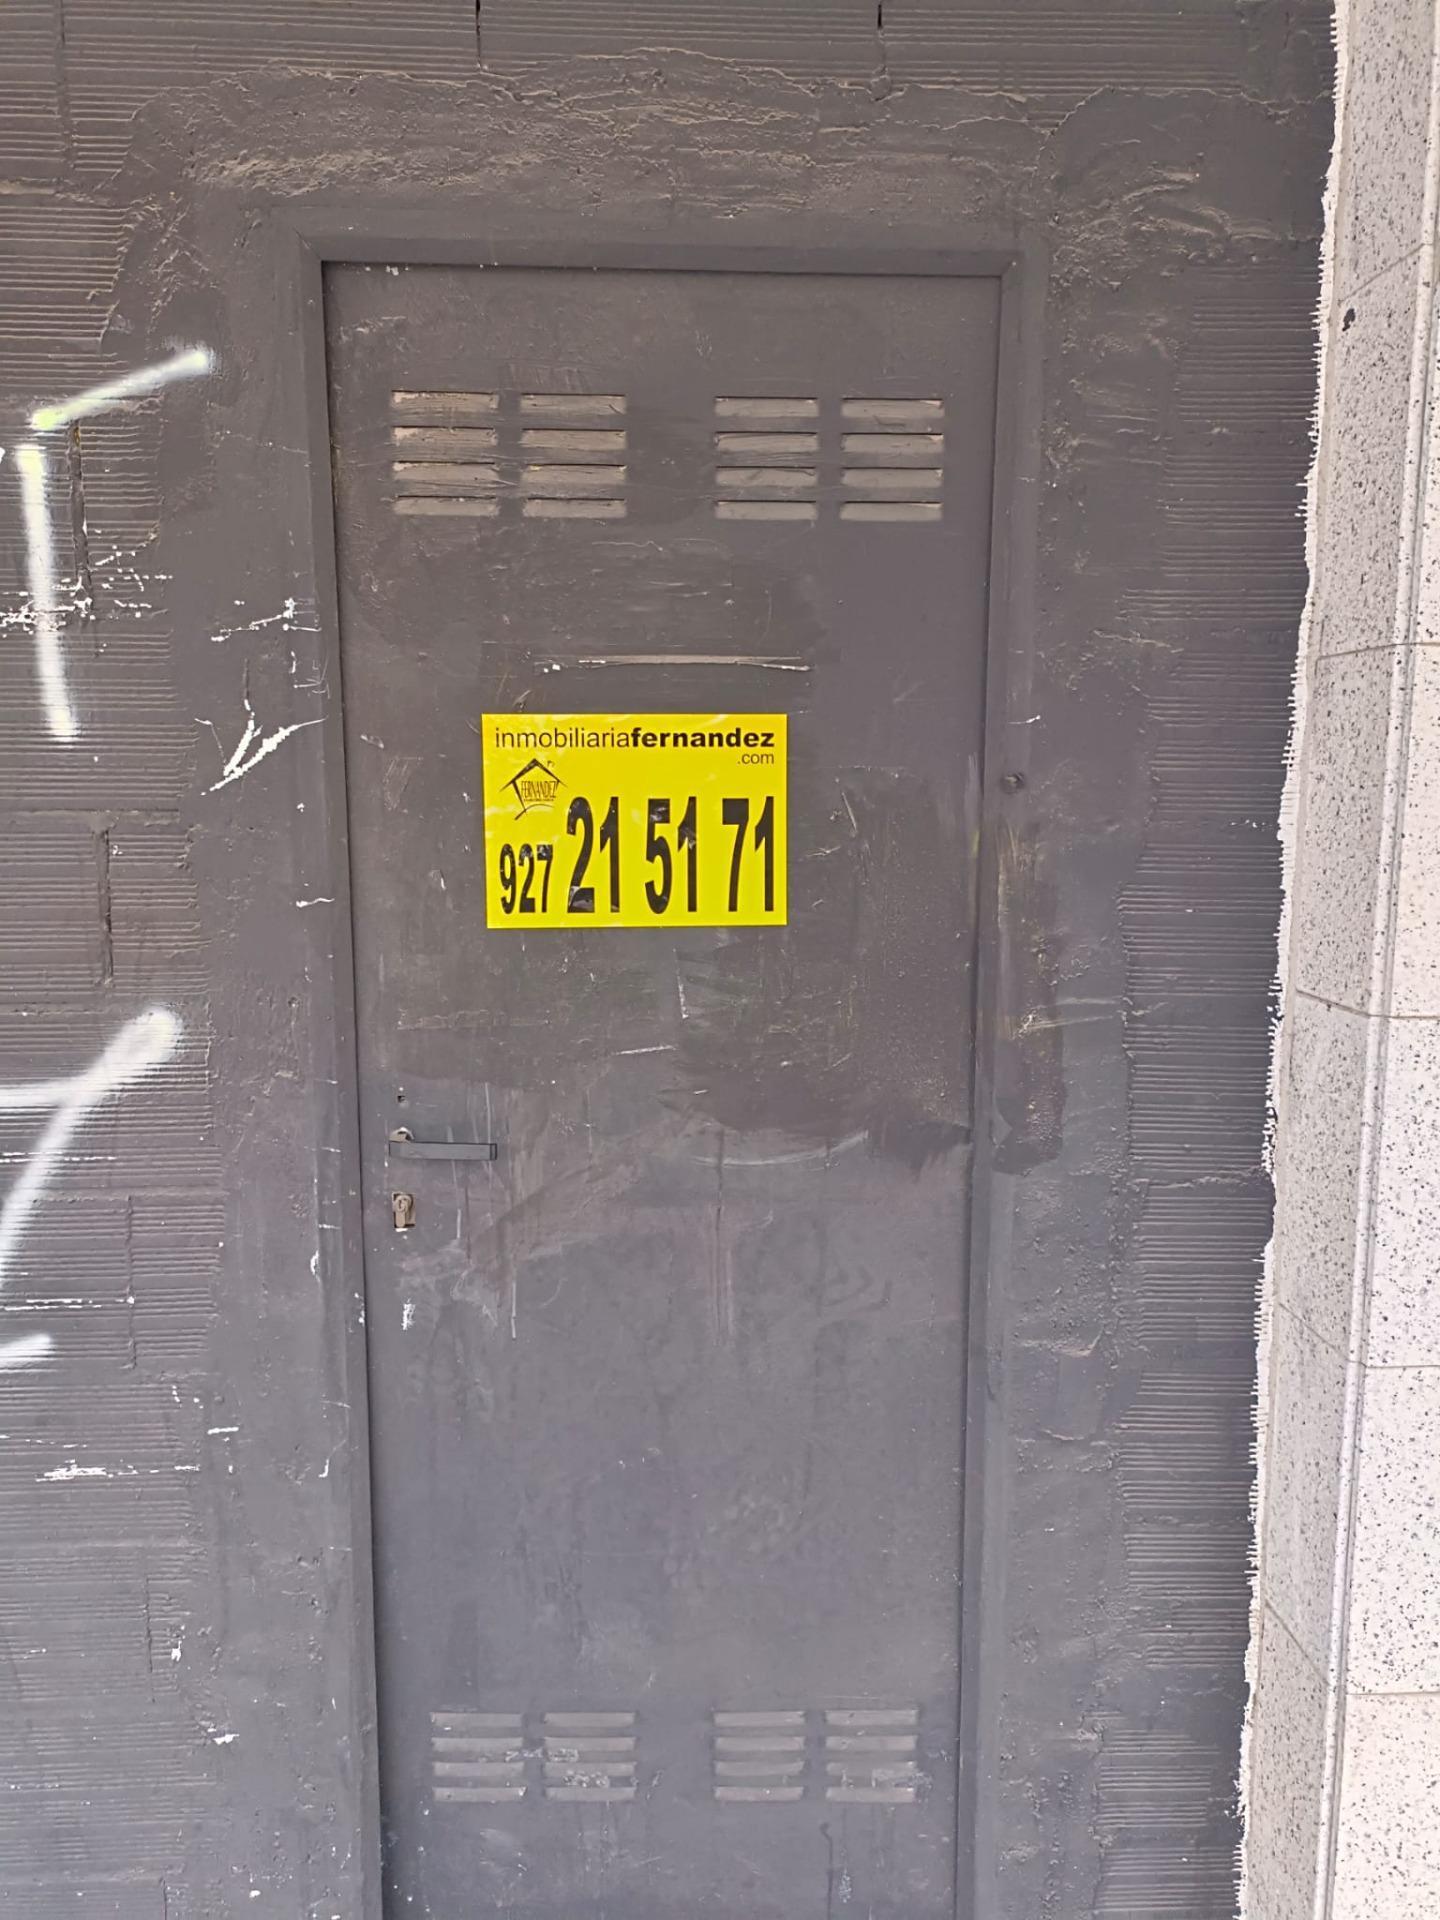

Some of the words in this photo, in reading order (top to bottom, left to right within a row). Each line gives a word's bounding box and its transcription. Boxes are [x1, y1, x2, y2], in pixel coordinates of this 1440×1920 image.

[495, 727, 775, 748] inmobiliariafernandez
[737, 752, 775, 765] .com
[521, 780, 556, 798] FERNANDEZ
[499, 843, 553, 914] 927
[566, 796, 620, 913] 21
[645, 796, 698, 914] 51
[722, 796, 775, 912] 71
